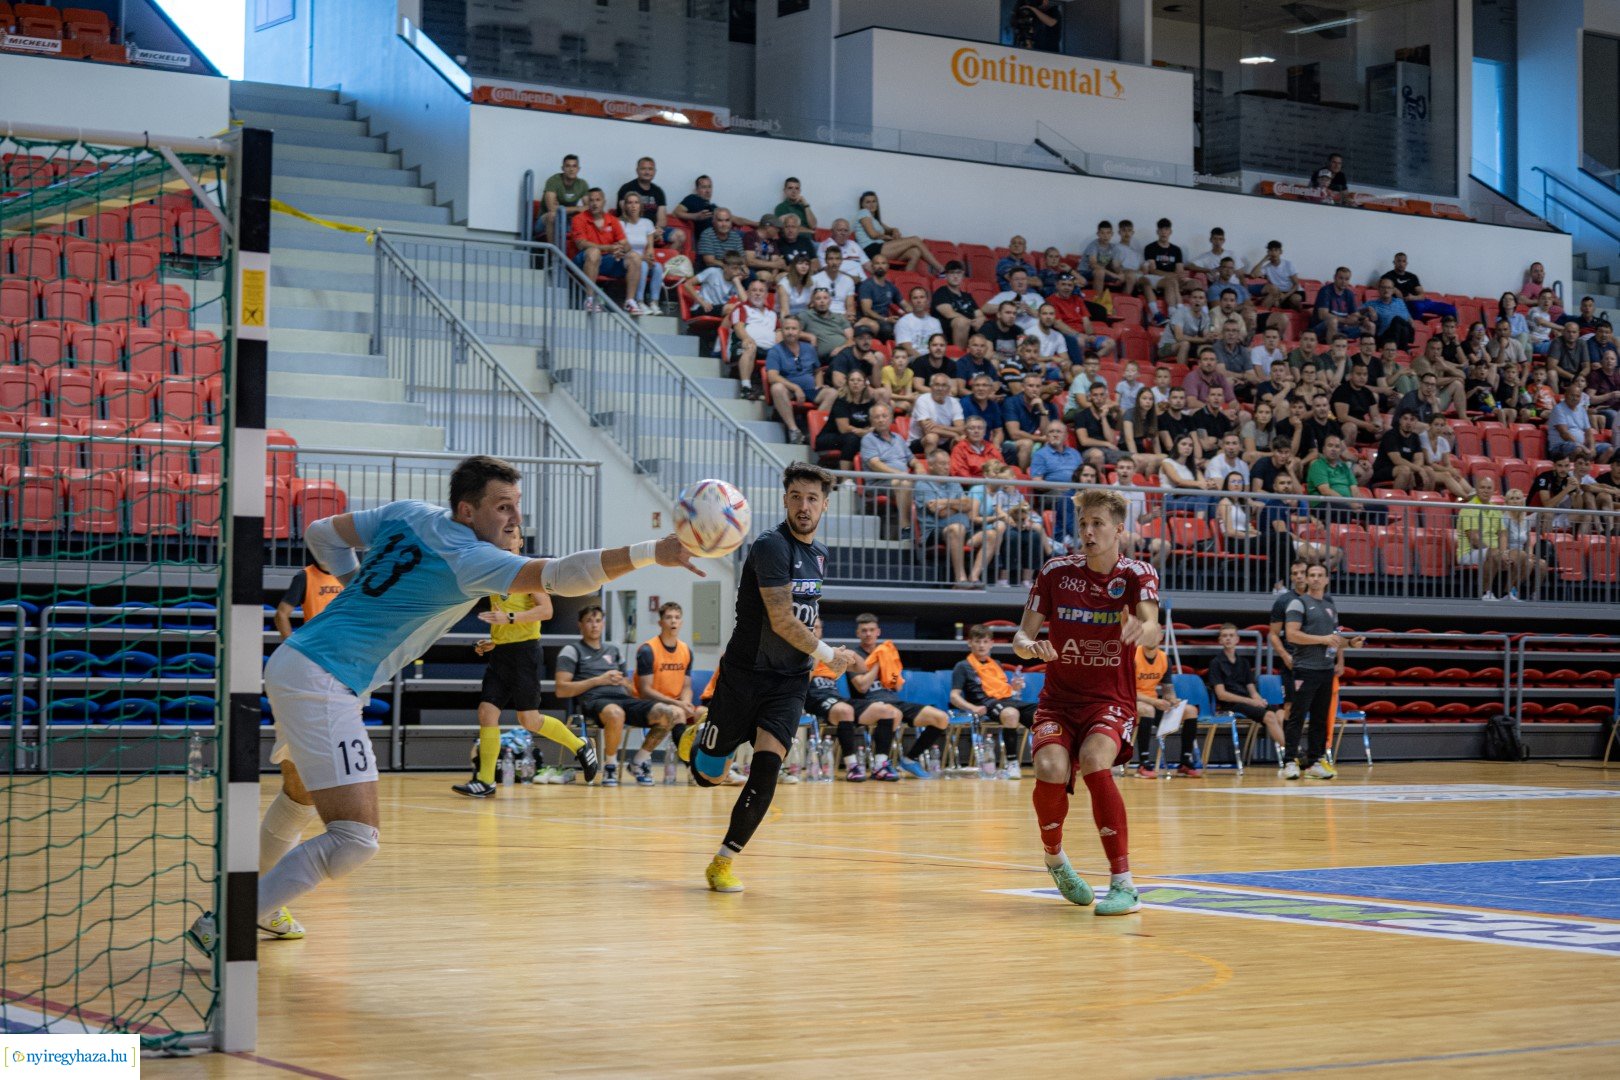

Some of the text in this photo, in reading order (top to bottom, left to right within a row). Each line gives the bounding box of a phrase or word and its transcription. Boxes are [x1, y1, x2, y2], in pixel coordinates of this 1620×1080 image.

[8, 37, 60, 49] MICHELIN
[139, 51, 188, 63] MICHELIN
[951, 47, 1101, 97] Continental
[355, 533, 422, 597] 13
[1059, 575, 1087, 593] 383
[1061, 654, 1121, 667] STUDIO
[702, 720, 719, 750] 10
[338, 739, 368, 775] 13
